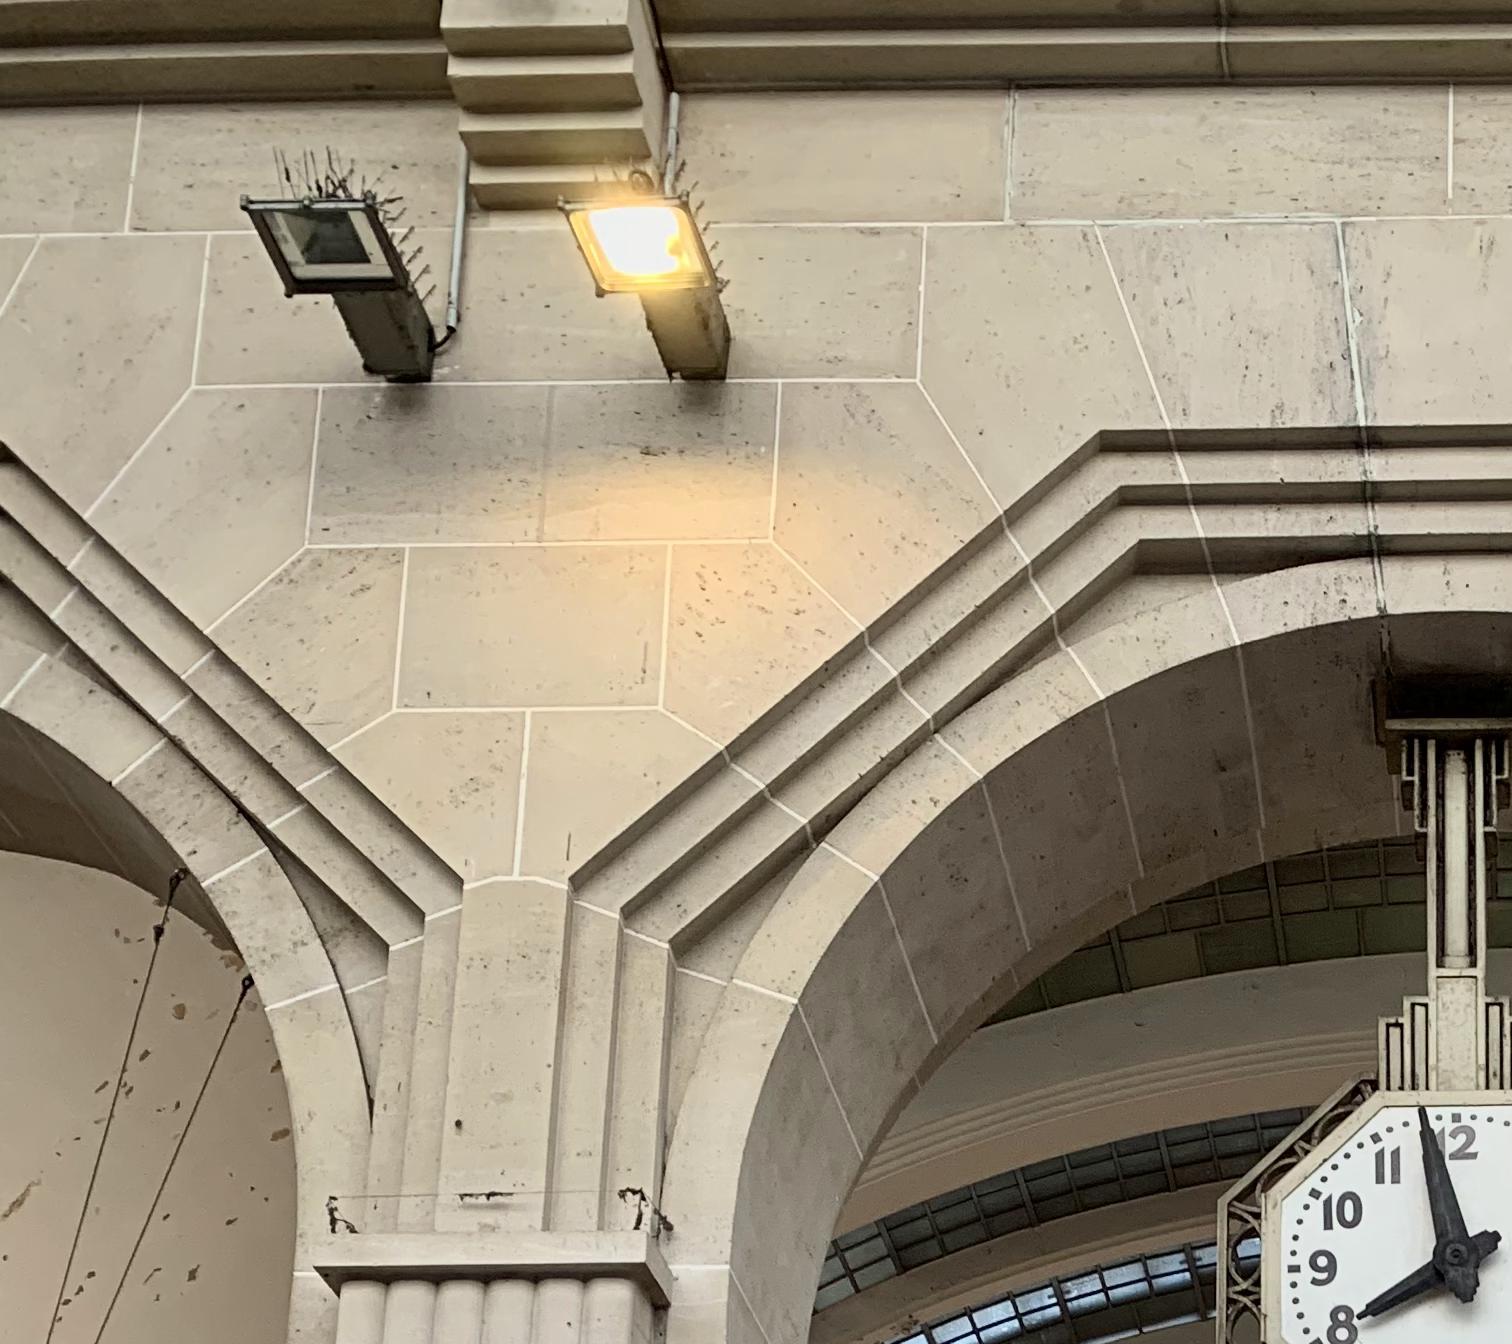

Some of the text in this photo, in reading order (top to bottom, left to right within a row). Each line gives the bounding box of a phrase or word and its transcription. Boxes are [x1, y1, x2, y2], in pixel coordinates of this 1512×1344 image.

[1374, 1145, 1401, 1184] 11
[1322, 1191, 1363, 1230] 10
[1308, 1249, 1338, 1286] 9
